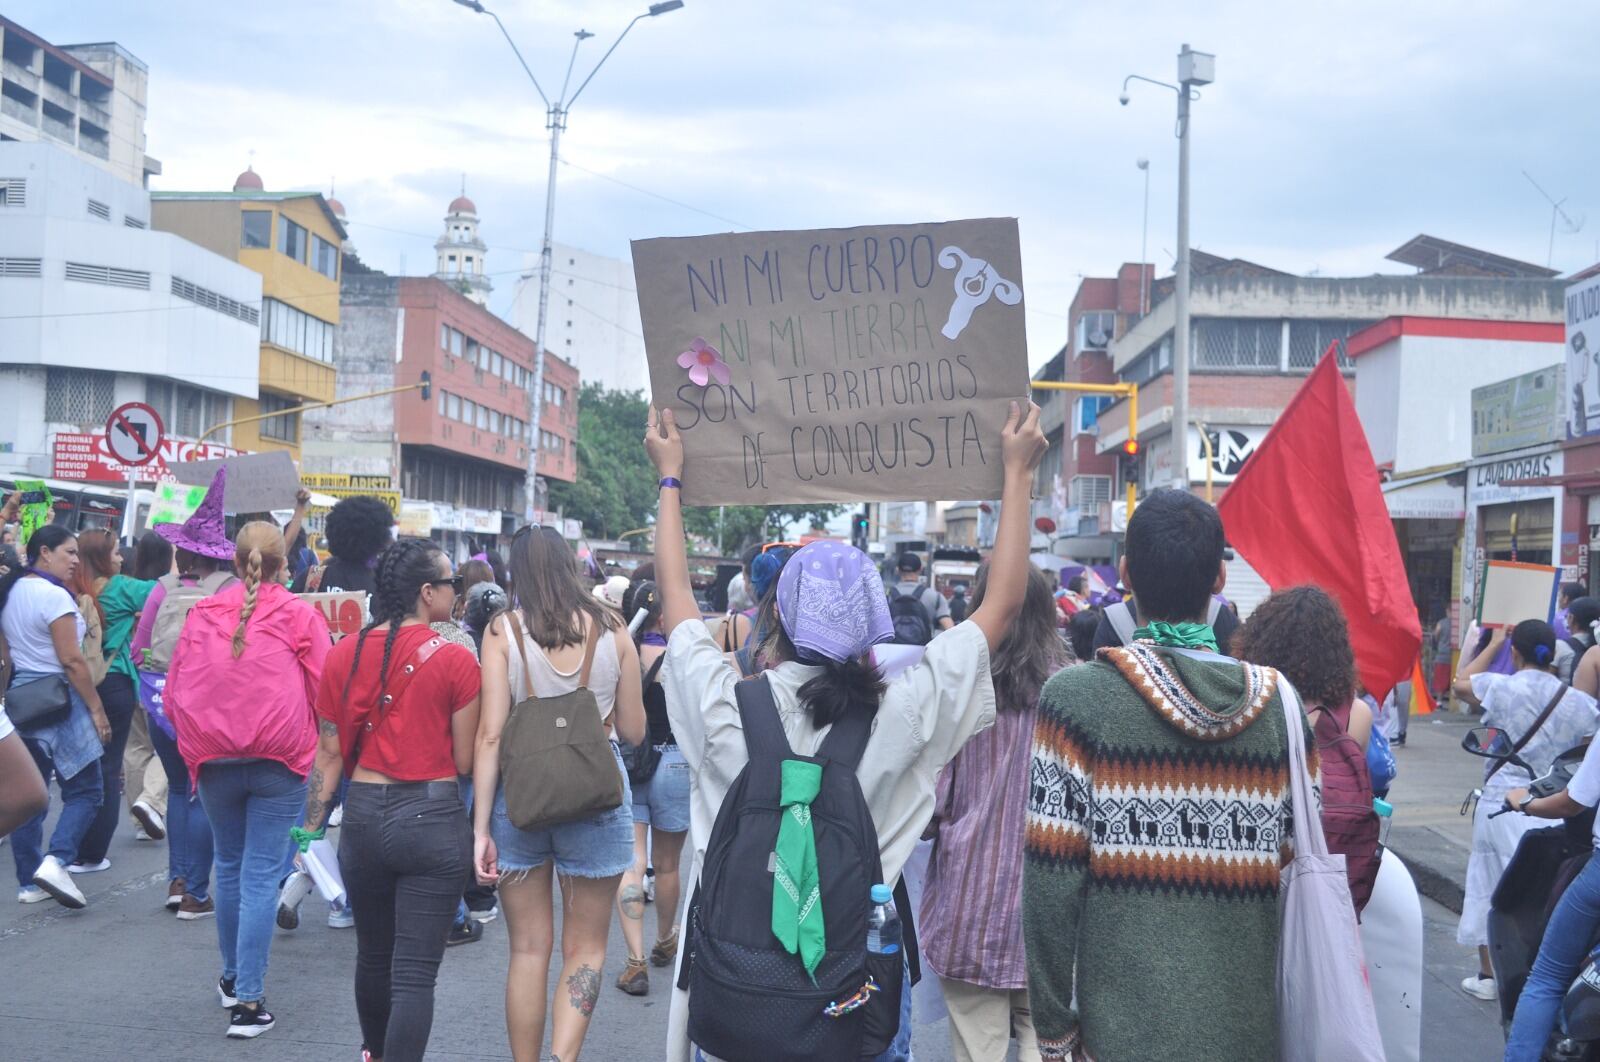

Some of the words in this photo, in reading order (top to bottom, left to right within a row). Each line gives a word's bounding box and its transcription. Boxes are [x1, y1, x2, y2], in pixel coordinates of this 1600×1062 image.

[687, 258, 727, 312] NI
[744, 249, 783, 305] MI
[808, 234, 935, 301] CUERPO
[720, 318, 750, 367] NI
[769, 315, 807, 368] MI
[823, 297, 935, 365] TIERRA
[675, 381, 756, 430] SON
[779, 354, 978, 416] TERRITORIOS
[56, 443, 66, 452] DE
[67, 444, 91, 453] COSER
[56, 452, 97, 462] REPUESTOS
[743, 431, 769, 489] DE
[790, 411, 986, 482] CONQUISTA
[55, 470, 87, 478] TECNICO
[56, 461, 89, 470] SERVICIO
[1476, 455, 1552, 487] LAVADORAS
